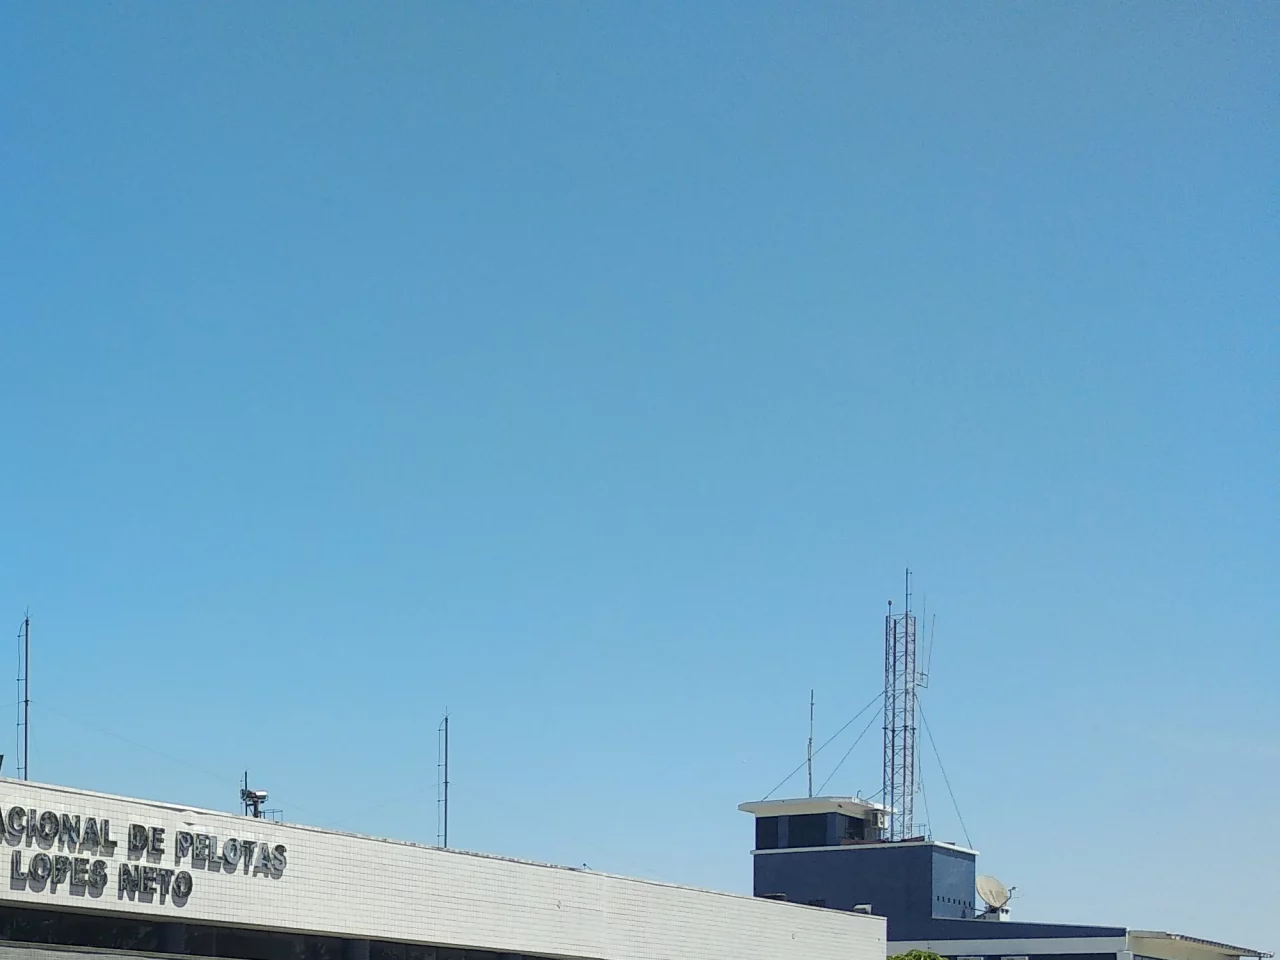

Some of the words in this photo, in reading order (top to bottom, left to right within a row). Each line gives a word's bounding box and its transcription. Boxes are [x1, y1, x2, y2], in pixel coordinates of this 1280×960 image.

[127, 823, 165, 855] DE
[175, 830, 288, 872] PELOTAS
[11, 849, 108, 891] LOPES
[119, 862, 193, 899] NETO
